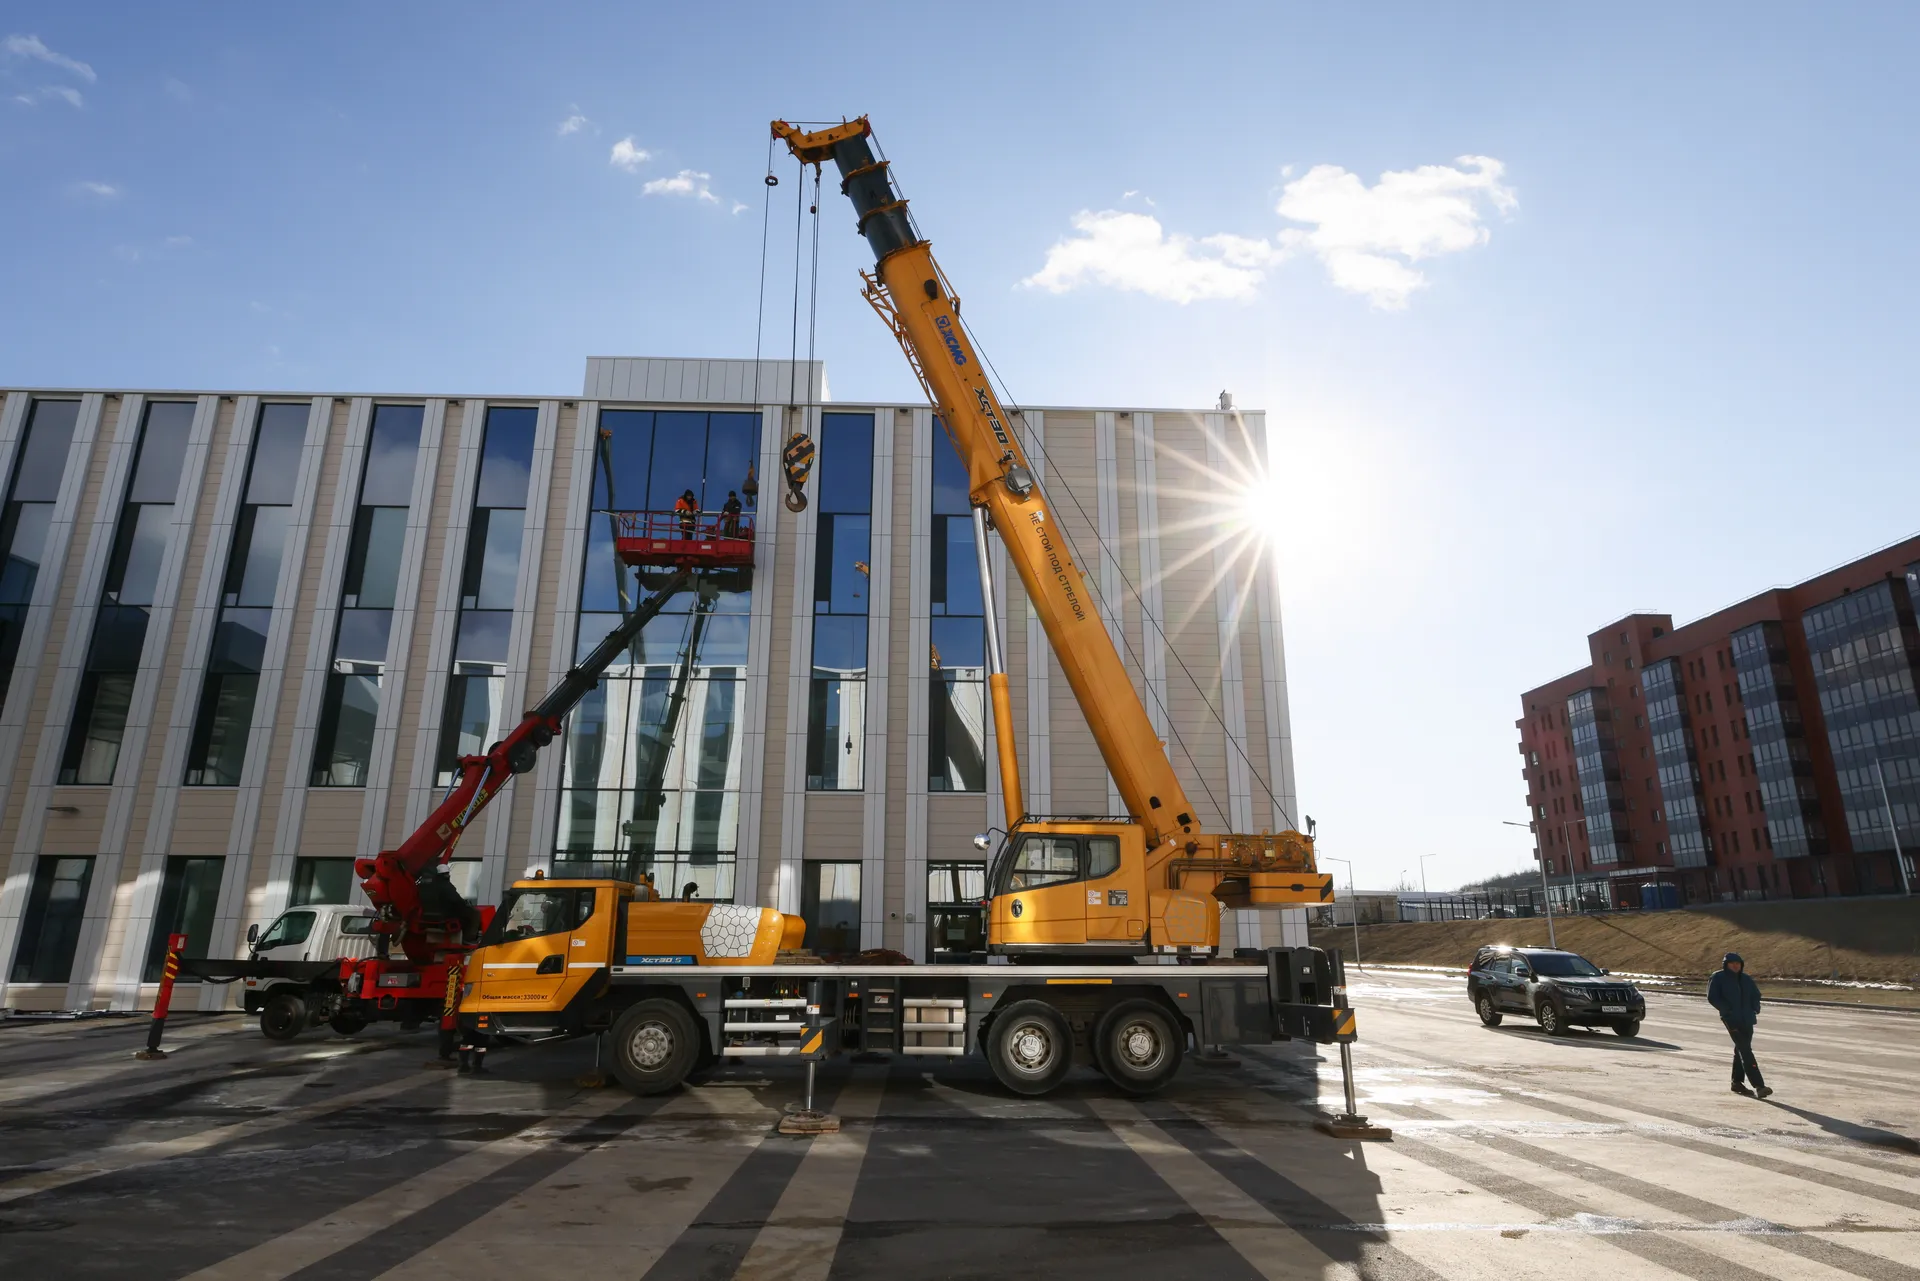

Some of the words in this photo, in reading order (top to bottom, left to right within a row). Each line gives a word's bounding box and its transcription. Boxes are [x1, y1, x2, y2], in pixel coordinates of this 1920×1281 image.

[941, 329, 967, 366] XCMG
[1029, 511, 1041, 526] НЕ
[1036, 526, 1054, 552] СТОЙ
[1048, 553, 1063, 575] ПОД
[1058, 575, 1086, 622] СТРЕЛОЙ!
